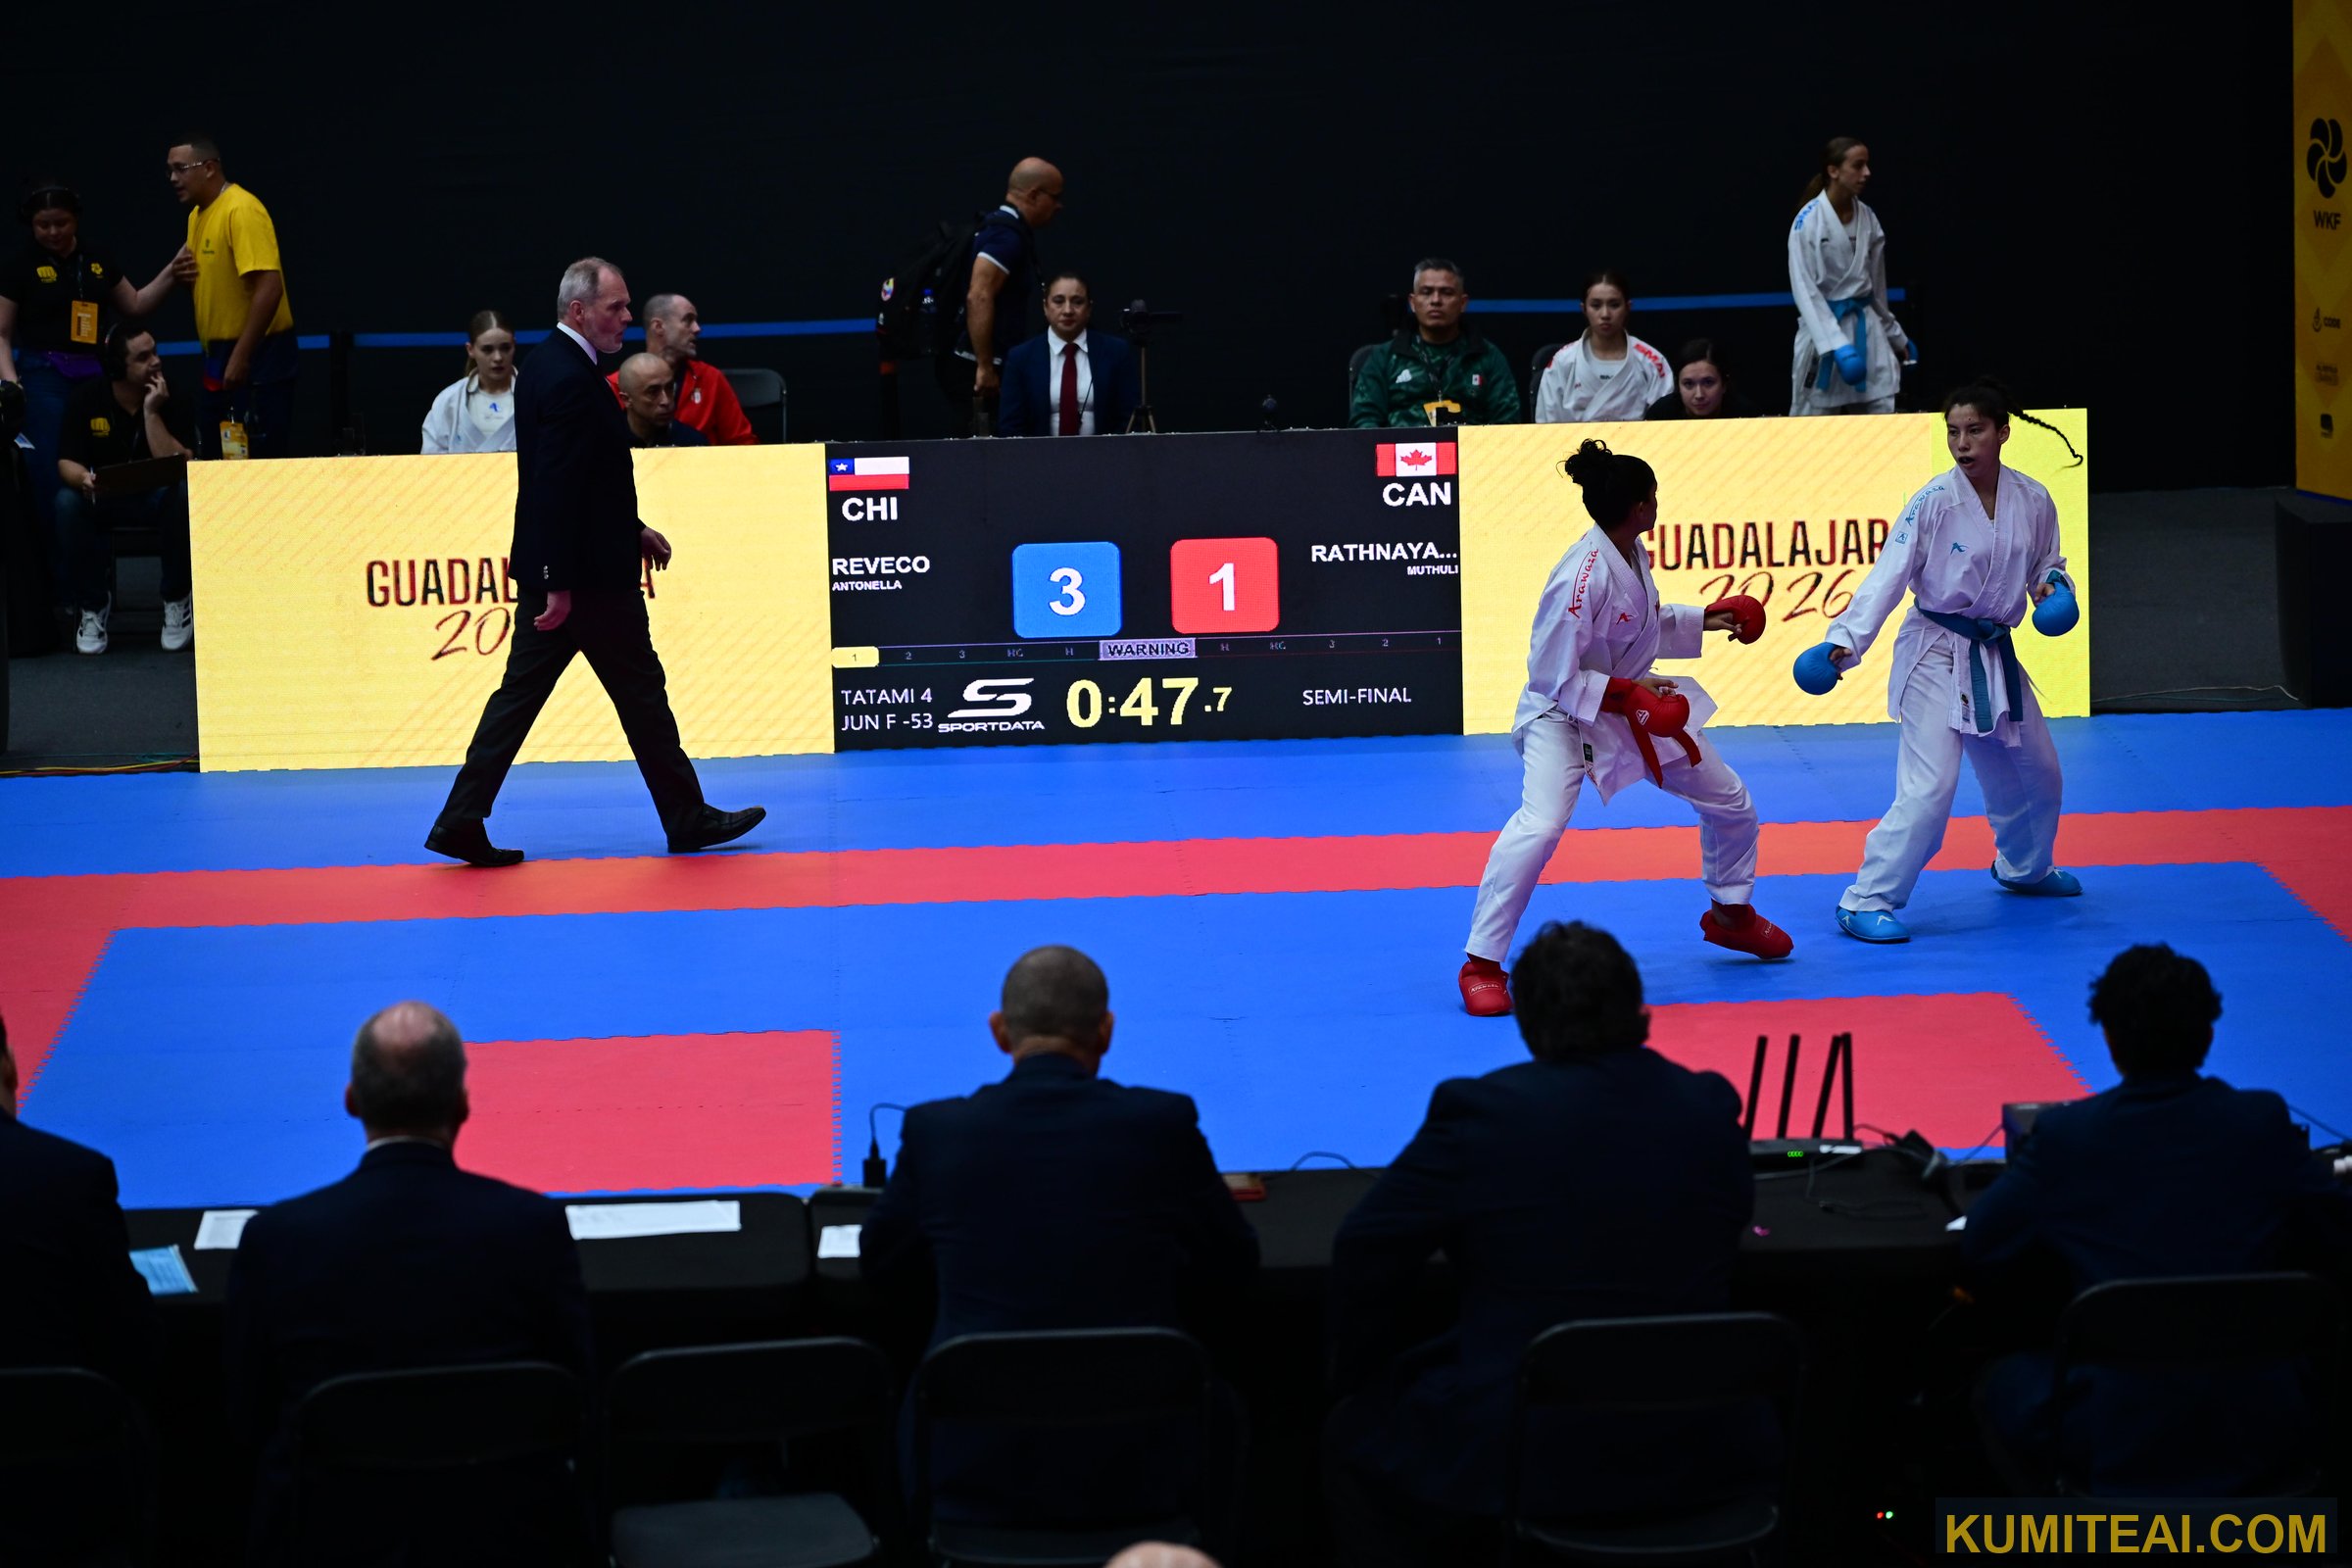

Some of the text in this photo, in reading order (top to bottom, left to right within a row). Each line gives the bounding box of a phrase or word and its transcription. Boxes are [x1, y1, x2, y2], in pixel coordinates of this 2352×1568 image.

[2313, 210, 2341, 230] WKF
[1383, 481, 1451, 507] CAN
[841, 496, 899, 521] CHI
[1311, 542, 1458, 562] RATHNAYA...
[832, 556, 931, 575] REVECO
[1407, 564, 1459, 575] MUTHULI
[831, 580, 903, 591] ANTONELLA
[1049, 566, 1086, 615] 3
[1208, 563, 1236, 612] 1
[1568, 548, 1598, 619] Arawaza
[431, 607, 512, 661] 20
[905, 652, 912, 661] 2
[958, 650, 965, 659] 3
[1107, 641, 1189, 657] WARNING
[1329, 639, 1336, 649] 3
[1383, 638, 1389, 647] 2
[841, 688, 933, 705] TATAMI 4
[1302, 687, 1412, 706] SEMI-FINAL
[841, 712, 933, 731] JUN F -53
[938, 720, 1046, 733] SPORTDATA
